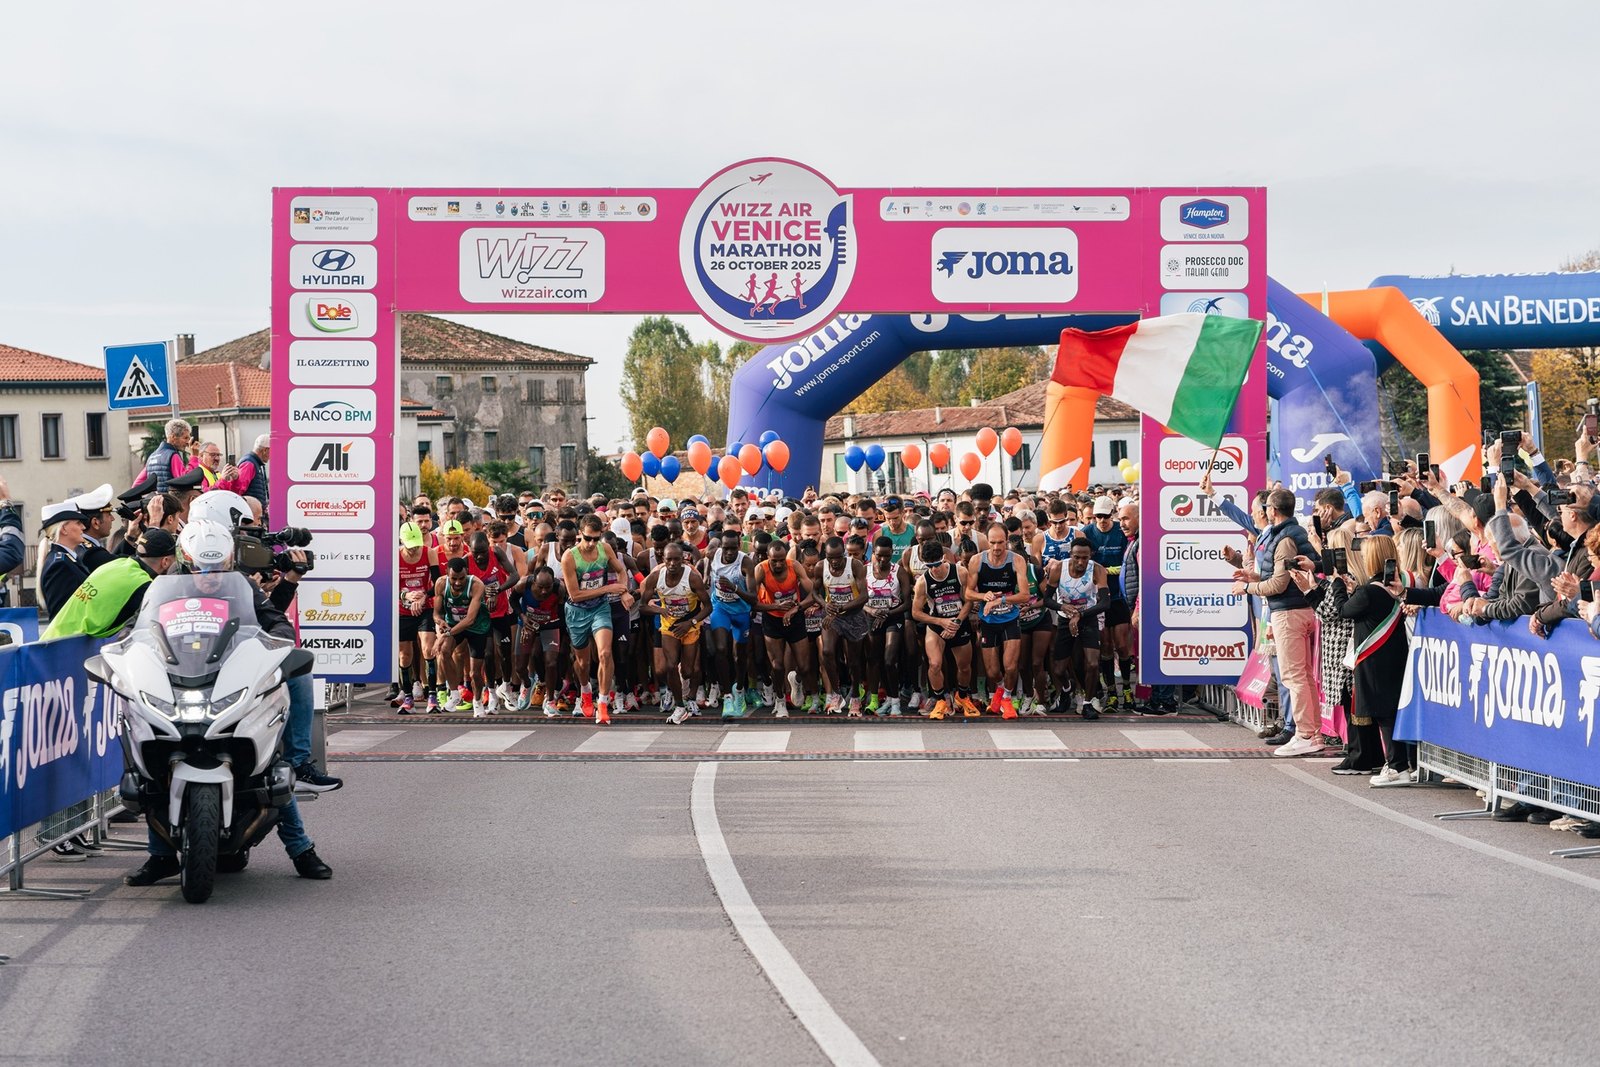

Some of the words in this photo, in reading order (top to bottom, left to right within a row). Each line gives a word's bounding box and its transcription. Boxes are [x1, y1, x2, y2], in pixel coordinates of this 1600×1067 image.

[720, 203, 772, 216] WIZZ
[778, 203, 812, 216] AIR
[1184, 208, 1224, 219] Hampton
[711, 221, 821, 241] VENICE
[711, 244, 821, 257] MARATHON
[711, 261, 725, 270] 26
[729, 261, 788, 270] OCTOBER
[791, 261, 821, 270] 2025
[1186, 257, 1226, 265] PROSECCO
[1228, 257, 1244, 265] DOC
[1186, 268, 1208, 277] ITALIAN
[1211, 268, 1229, 277] GENIO
[303, 275, 364, 285] HYUNDAI
[501, 286, 587, 298] wizzair.com
[317, 304, 351, 317] Dole
[795, 329, 880, 397] www.joma-sport.com
[294, 411, 342, 421] BANCO
[345, 411, 371, 421] BPM
[1165, 459, 1234, 473] deporvilage
[1289, 472, 1355, 493] Jom
[296, 500, 330, 509] Corriere
[343, 500, 366, 512] Sport
[1166, 562, 1180, 571] ICE
[1165, 594, 1224, 606] Bavaria
[305, 609, 366, 621] Bibanesi
[1169, 608, 1194, 616] Family
[166, 617, 223, 626] AUTORIZZATO
[1163, 641, 1245, 657] TUTTOSPORT
